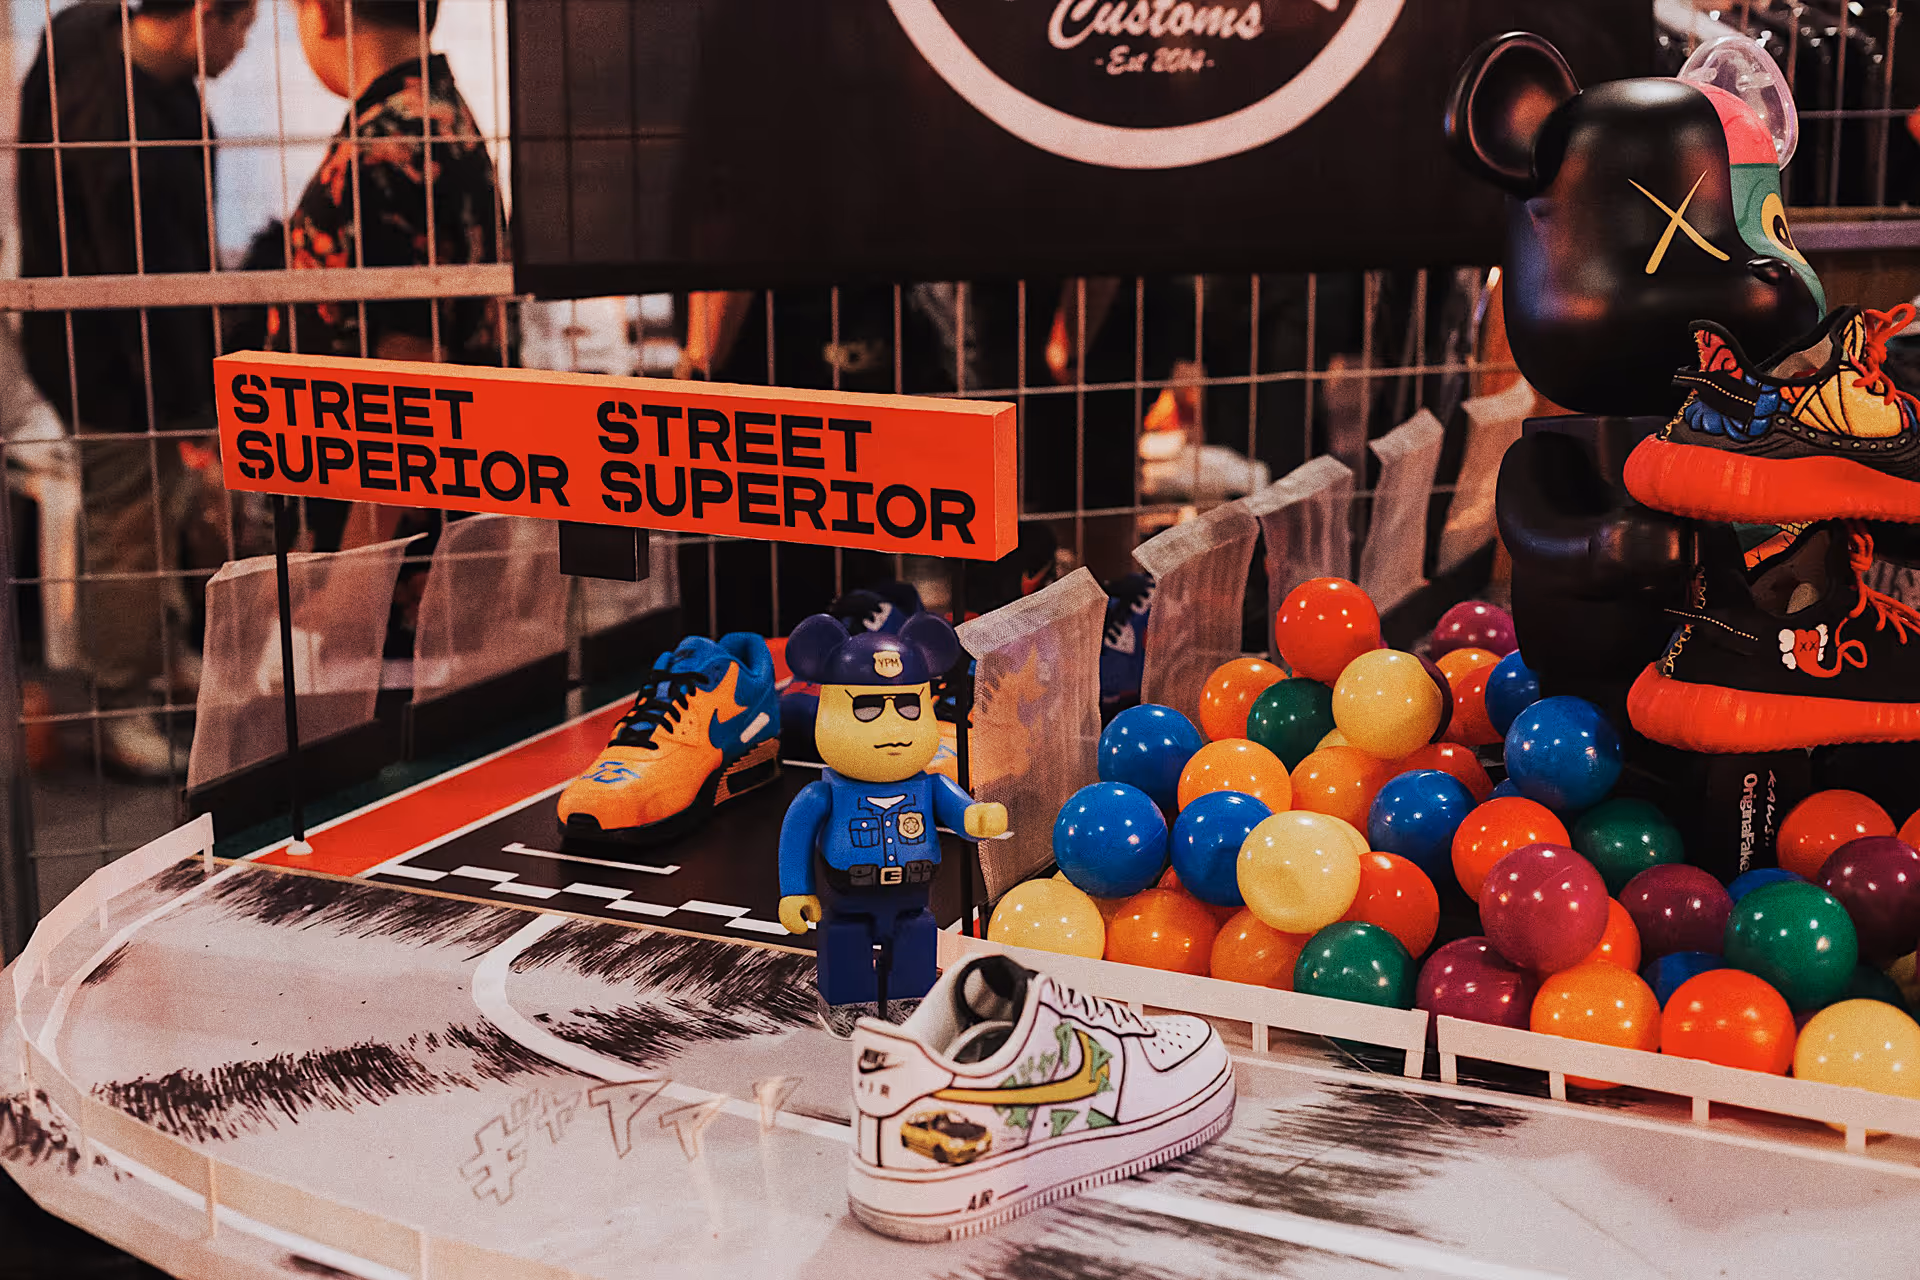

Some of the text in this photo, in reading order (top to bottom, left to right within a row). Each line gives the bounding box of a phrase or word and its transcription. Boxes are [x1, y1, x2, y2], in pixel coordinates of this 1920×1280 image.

[1048, 0, 1263, 49] Customs
[232, 374, 872, 472] STREET STREET
[237, 430, 975, 544] SUPERIOR SUPERIOR
